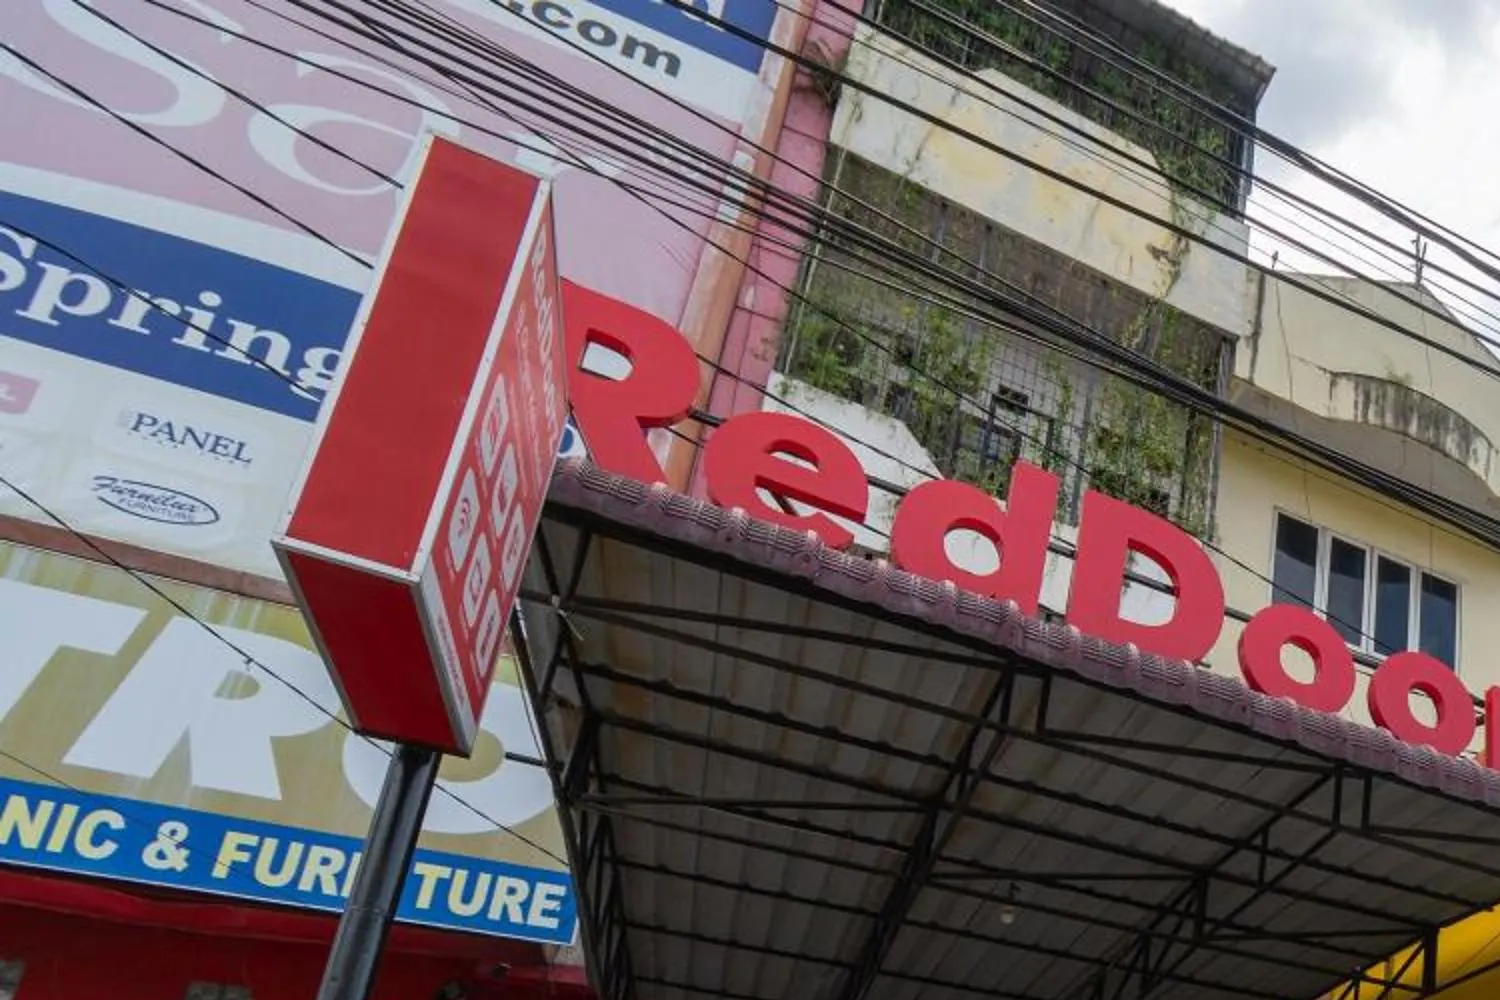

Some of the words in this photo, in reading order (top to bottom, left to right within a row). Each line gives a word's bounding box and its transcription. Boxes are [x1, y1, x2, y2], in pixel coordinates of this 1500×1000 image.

[131, 412, 252, 463] PANEL
[0, 794, 126, 860] NIC
[141, 820, 191, 872] &
[211, 830, 568, 929] FURTURE
